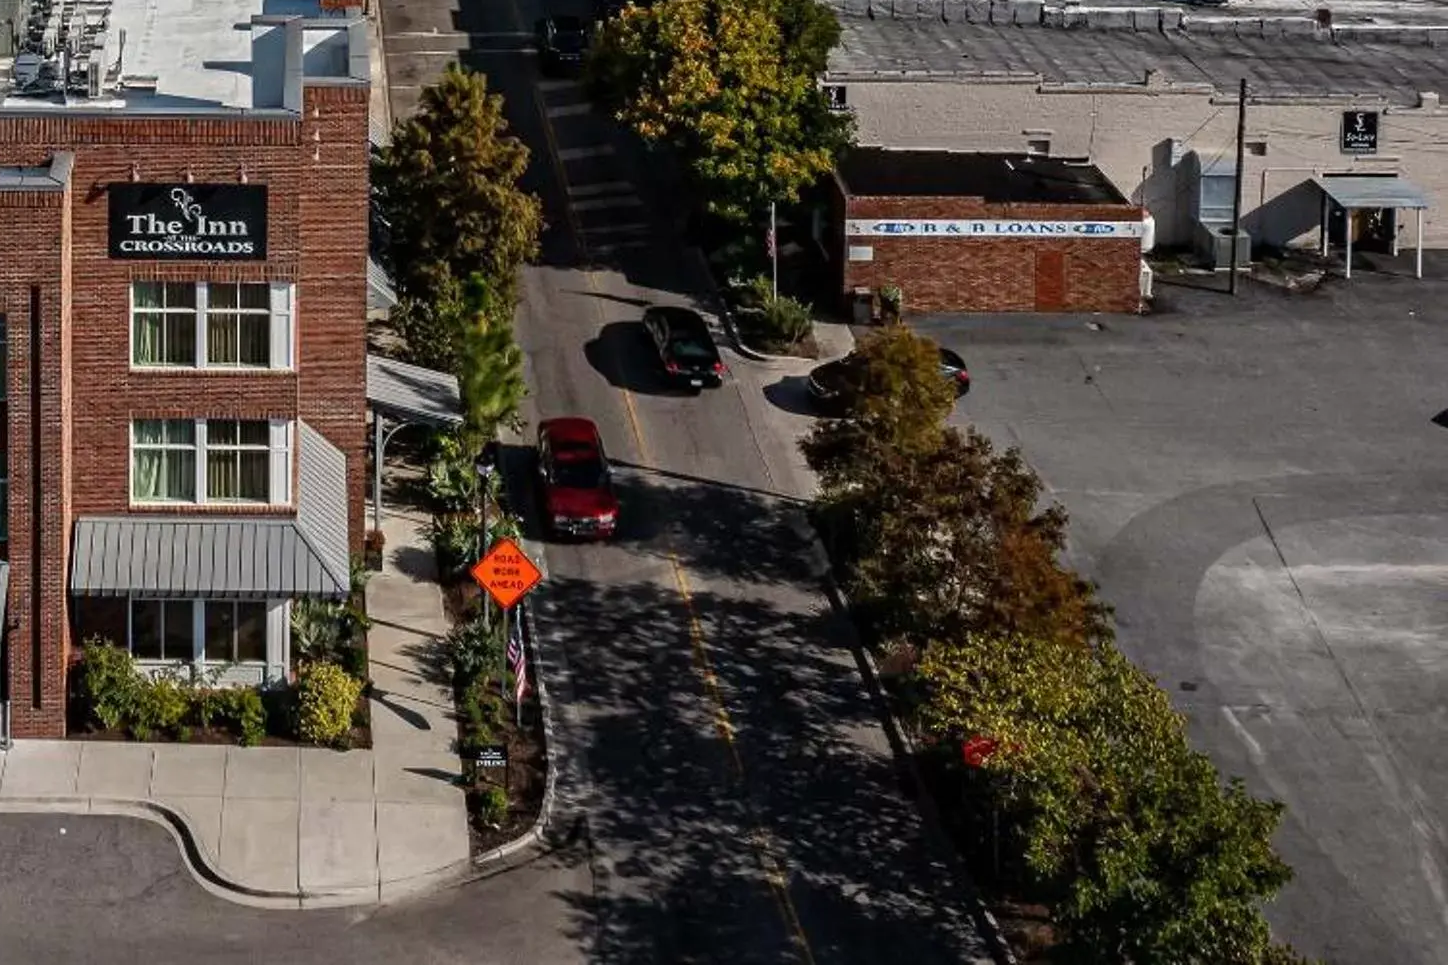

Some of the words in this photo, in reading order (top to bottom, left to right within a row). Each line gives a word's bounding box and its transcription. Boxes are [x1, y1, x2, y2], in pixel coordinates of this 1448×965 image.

[126, 213, 183, 234] The
[196, 216, 248, 235] Inn
[924, 223, 936, 233] B
[946, 223, 960, 233] &
[972, 223, 985, 233] B
[994, 223, 1066, 234] LOANS
[119, 240, 254, 253] CROSSROADS
[493, 554, 521, 564] ROAD
[493, 567, 520, 576] WORK
[490, 580, 524, 590] AHEAD
